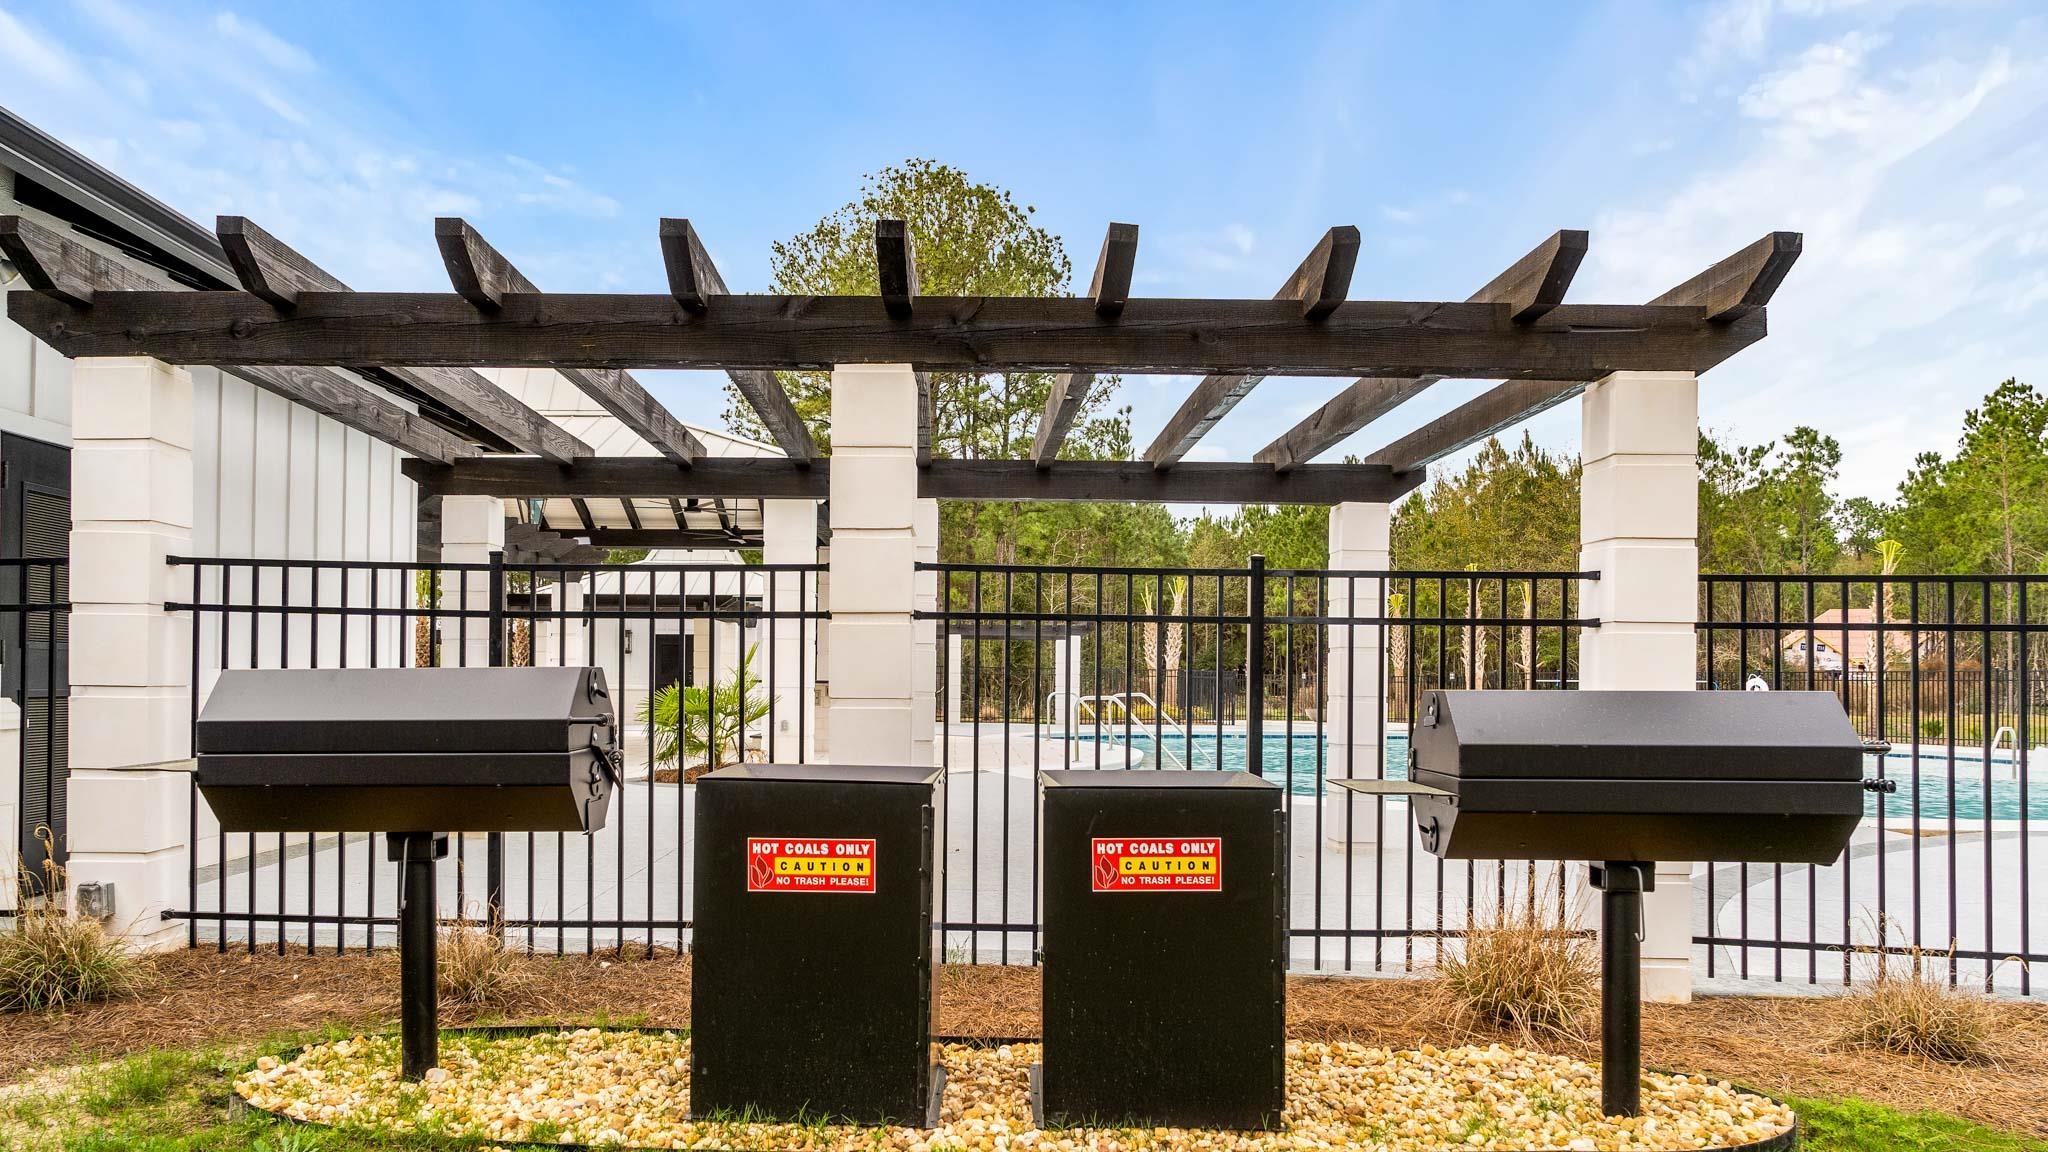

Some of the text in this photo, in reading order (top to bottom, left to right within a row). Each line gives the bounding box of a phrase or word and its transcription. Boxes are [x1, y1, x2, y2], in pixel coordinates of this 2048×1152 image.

[752, 843, 870, 855] HOT COALS ONLY
[1097, 843, 1215, 854] HOT COALS ONLY
[780, 862, 864, 871] CAUTION
[1125, 861, 1210, 870] CAUTION
[776, 877, 869, 886] NO TRASH PLEASE!
[1121, 877, 1135, 885] NO
[1175, 877, 1215, 885] PLEASE!
